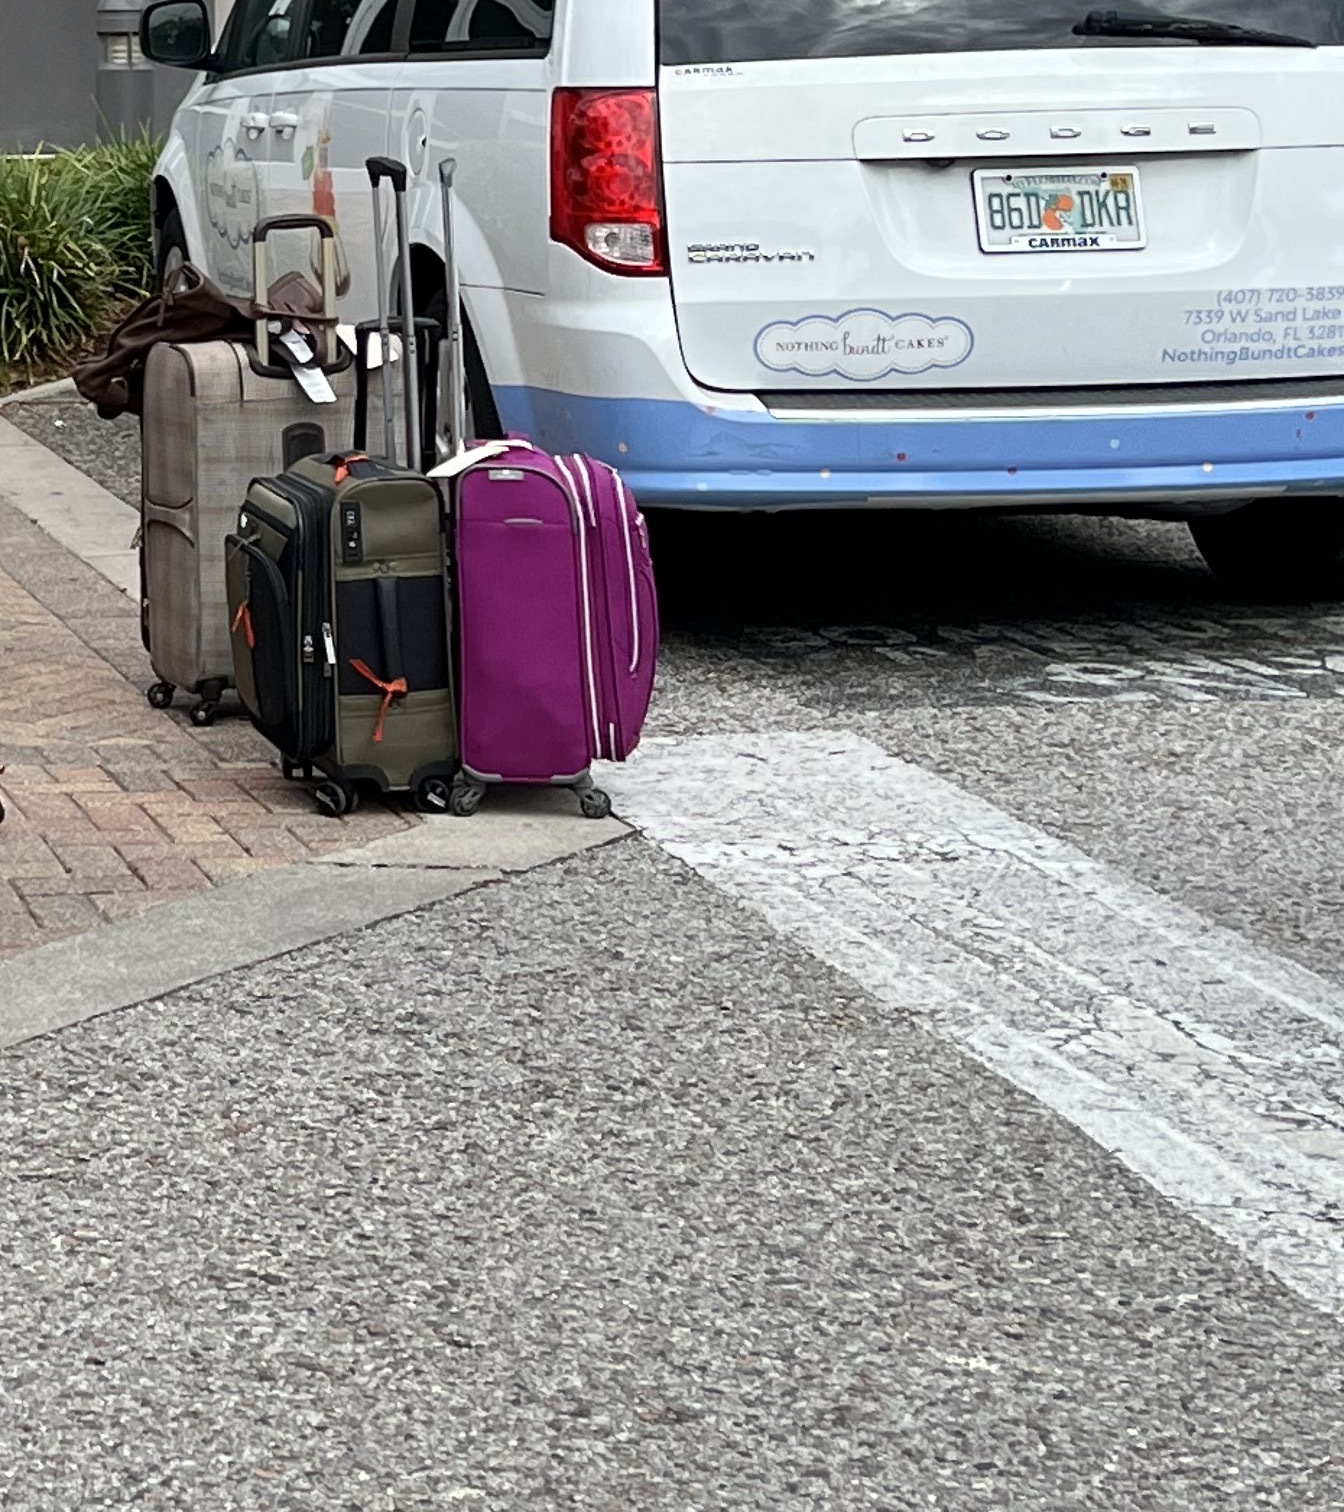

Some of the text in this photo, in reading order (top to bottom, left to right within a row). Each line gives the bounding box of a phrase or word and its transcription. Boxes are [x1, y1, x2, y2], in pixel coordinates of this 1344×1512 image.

[1217, 289, 1261, 307] (407)
[1183, 305, 1342, 325] 7339 W Sand Lake
[775, 330, 945, 356] NOTHING bundt CAKES
[1201, 327, 1277, 345] Orlando,
[1283, 326, 1302, 341] FL
